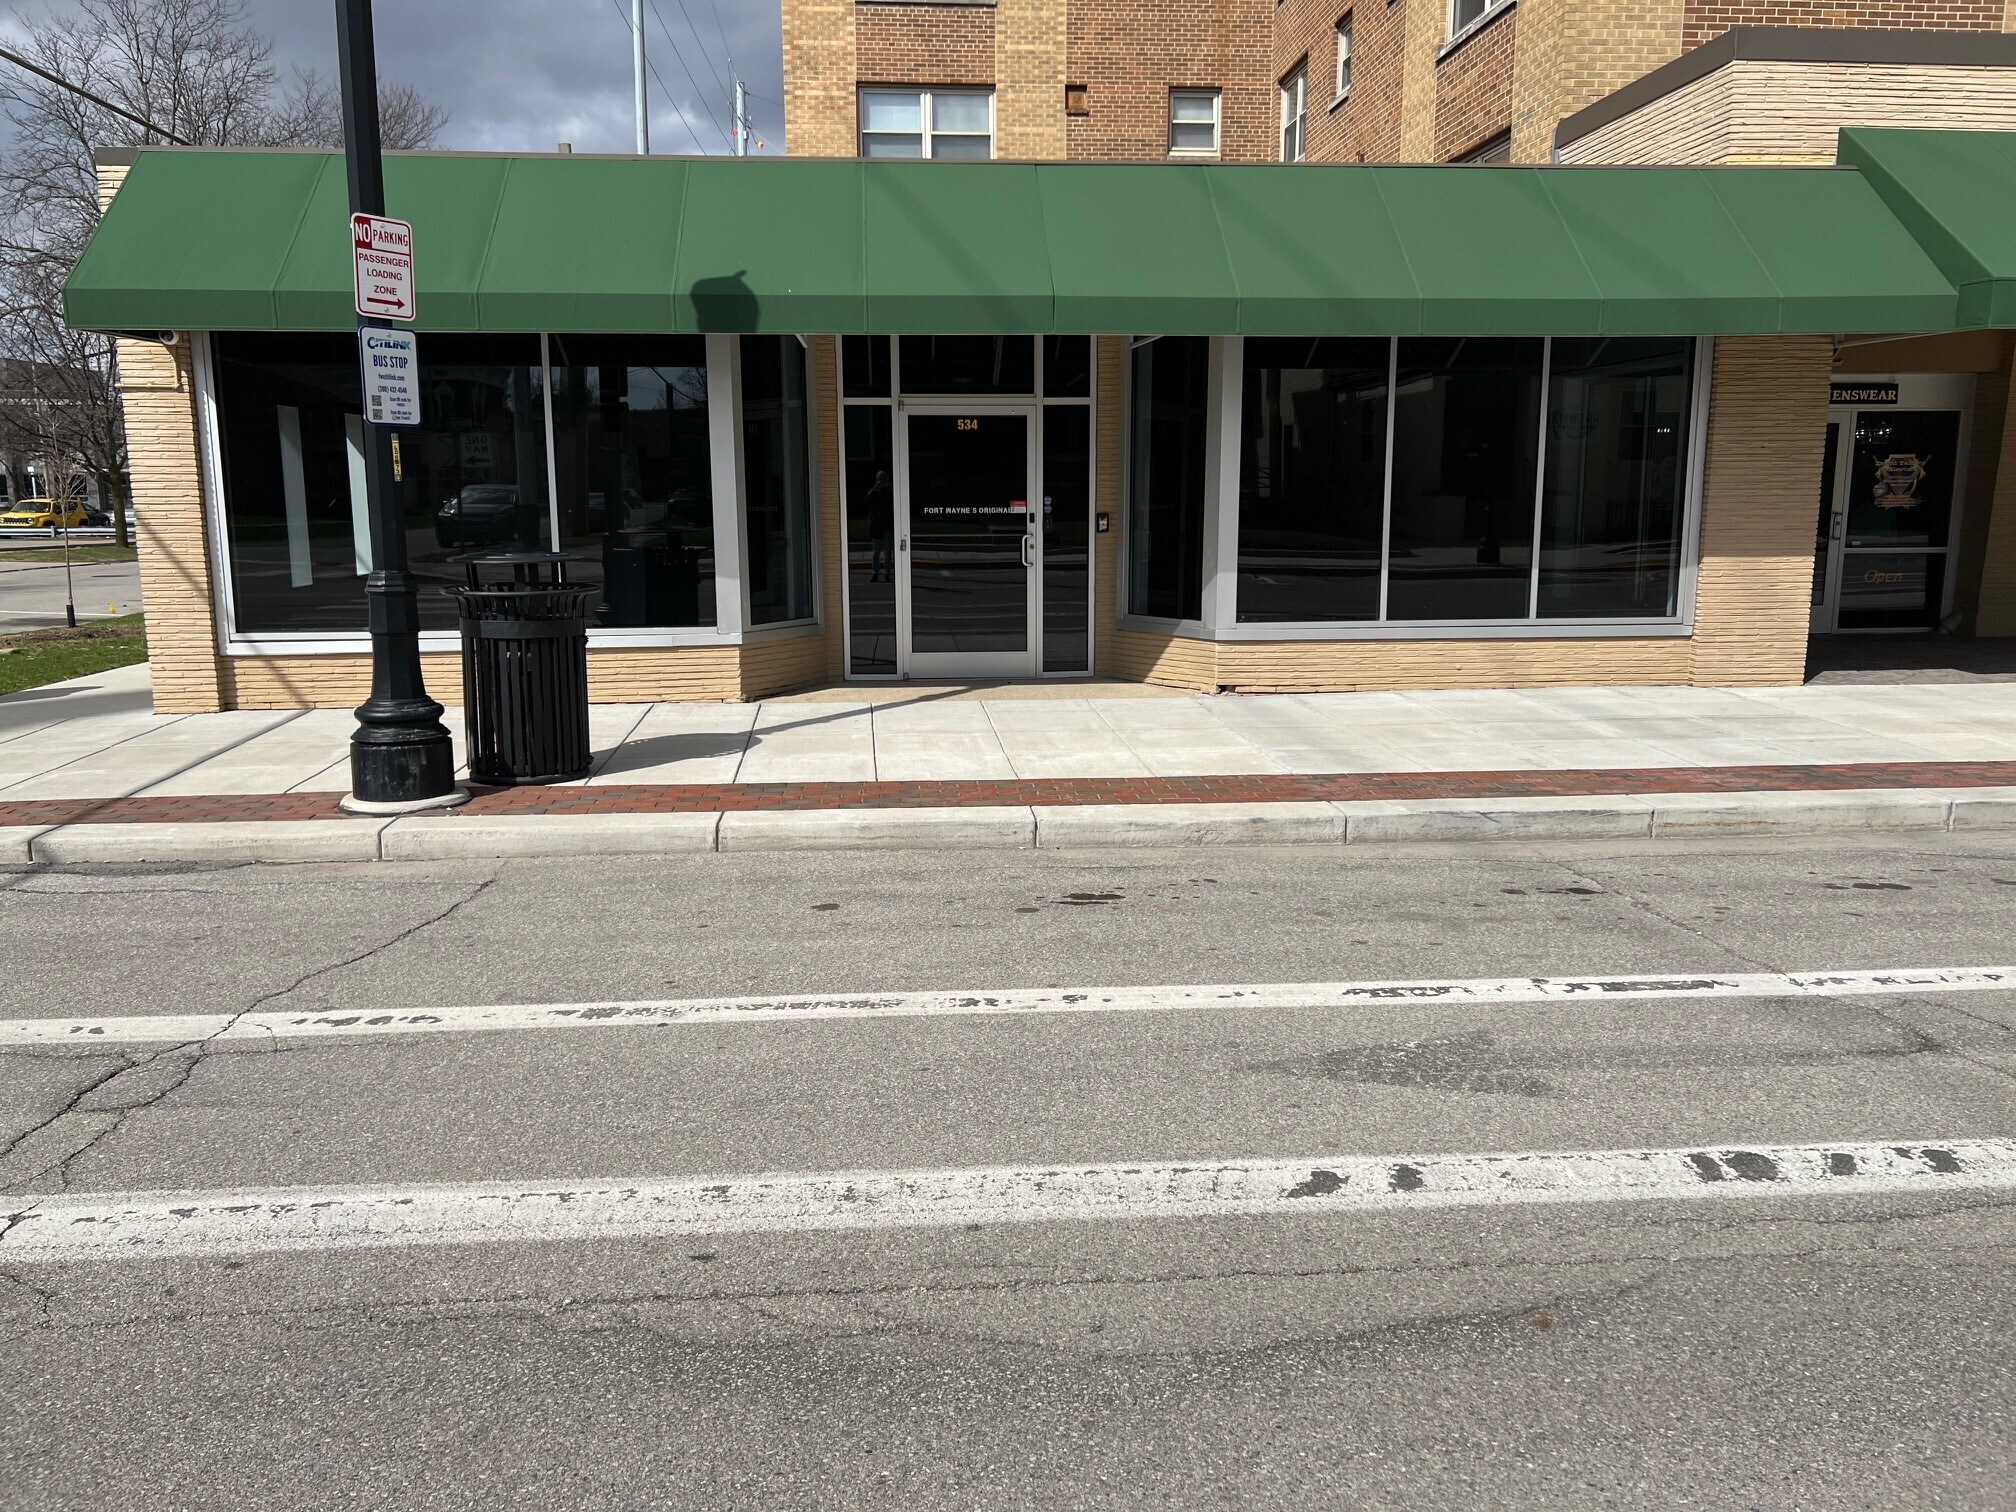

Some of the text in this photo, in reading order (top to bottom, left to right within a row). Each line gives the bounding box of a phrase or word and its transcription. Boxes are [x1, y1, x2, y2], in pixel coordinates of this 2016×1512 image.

[355, 222, 409, 247] NO PARKING
[358, 252, 410, 269] PASSENGER
[366, 268, 403, 281] LOADING
[373, 284, 398, 296] ZONE
[373, 354, 409, 369] BUS STOP
[1829, 389, 1896, 401] ENSWEAR
[957, 419, 979, 431] 534
[945, 506, 977, 514] WAYNE'S
[1864, 569, 1905, 584] Open
